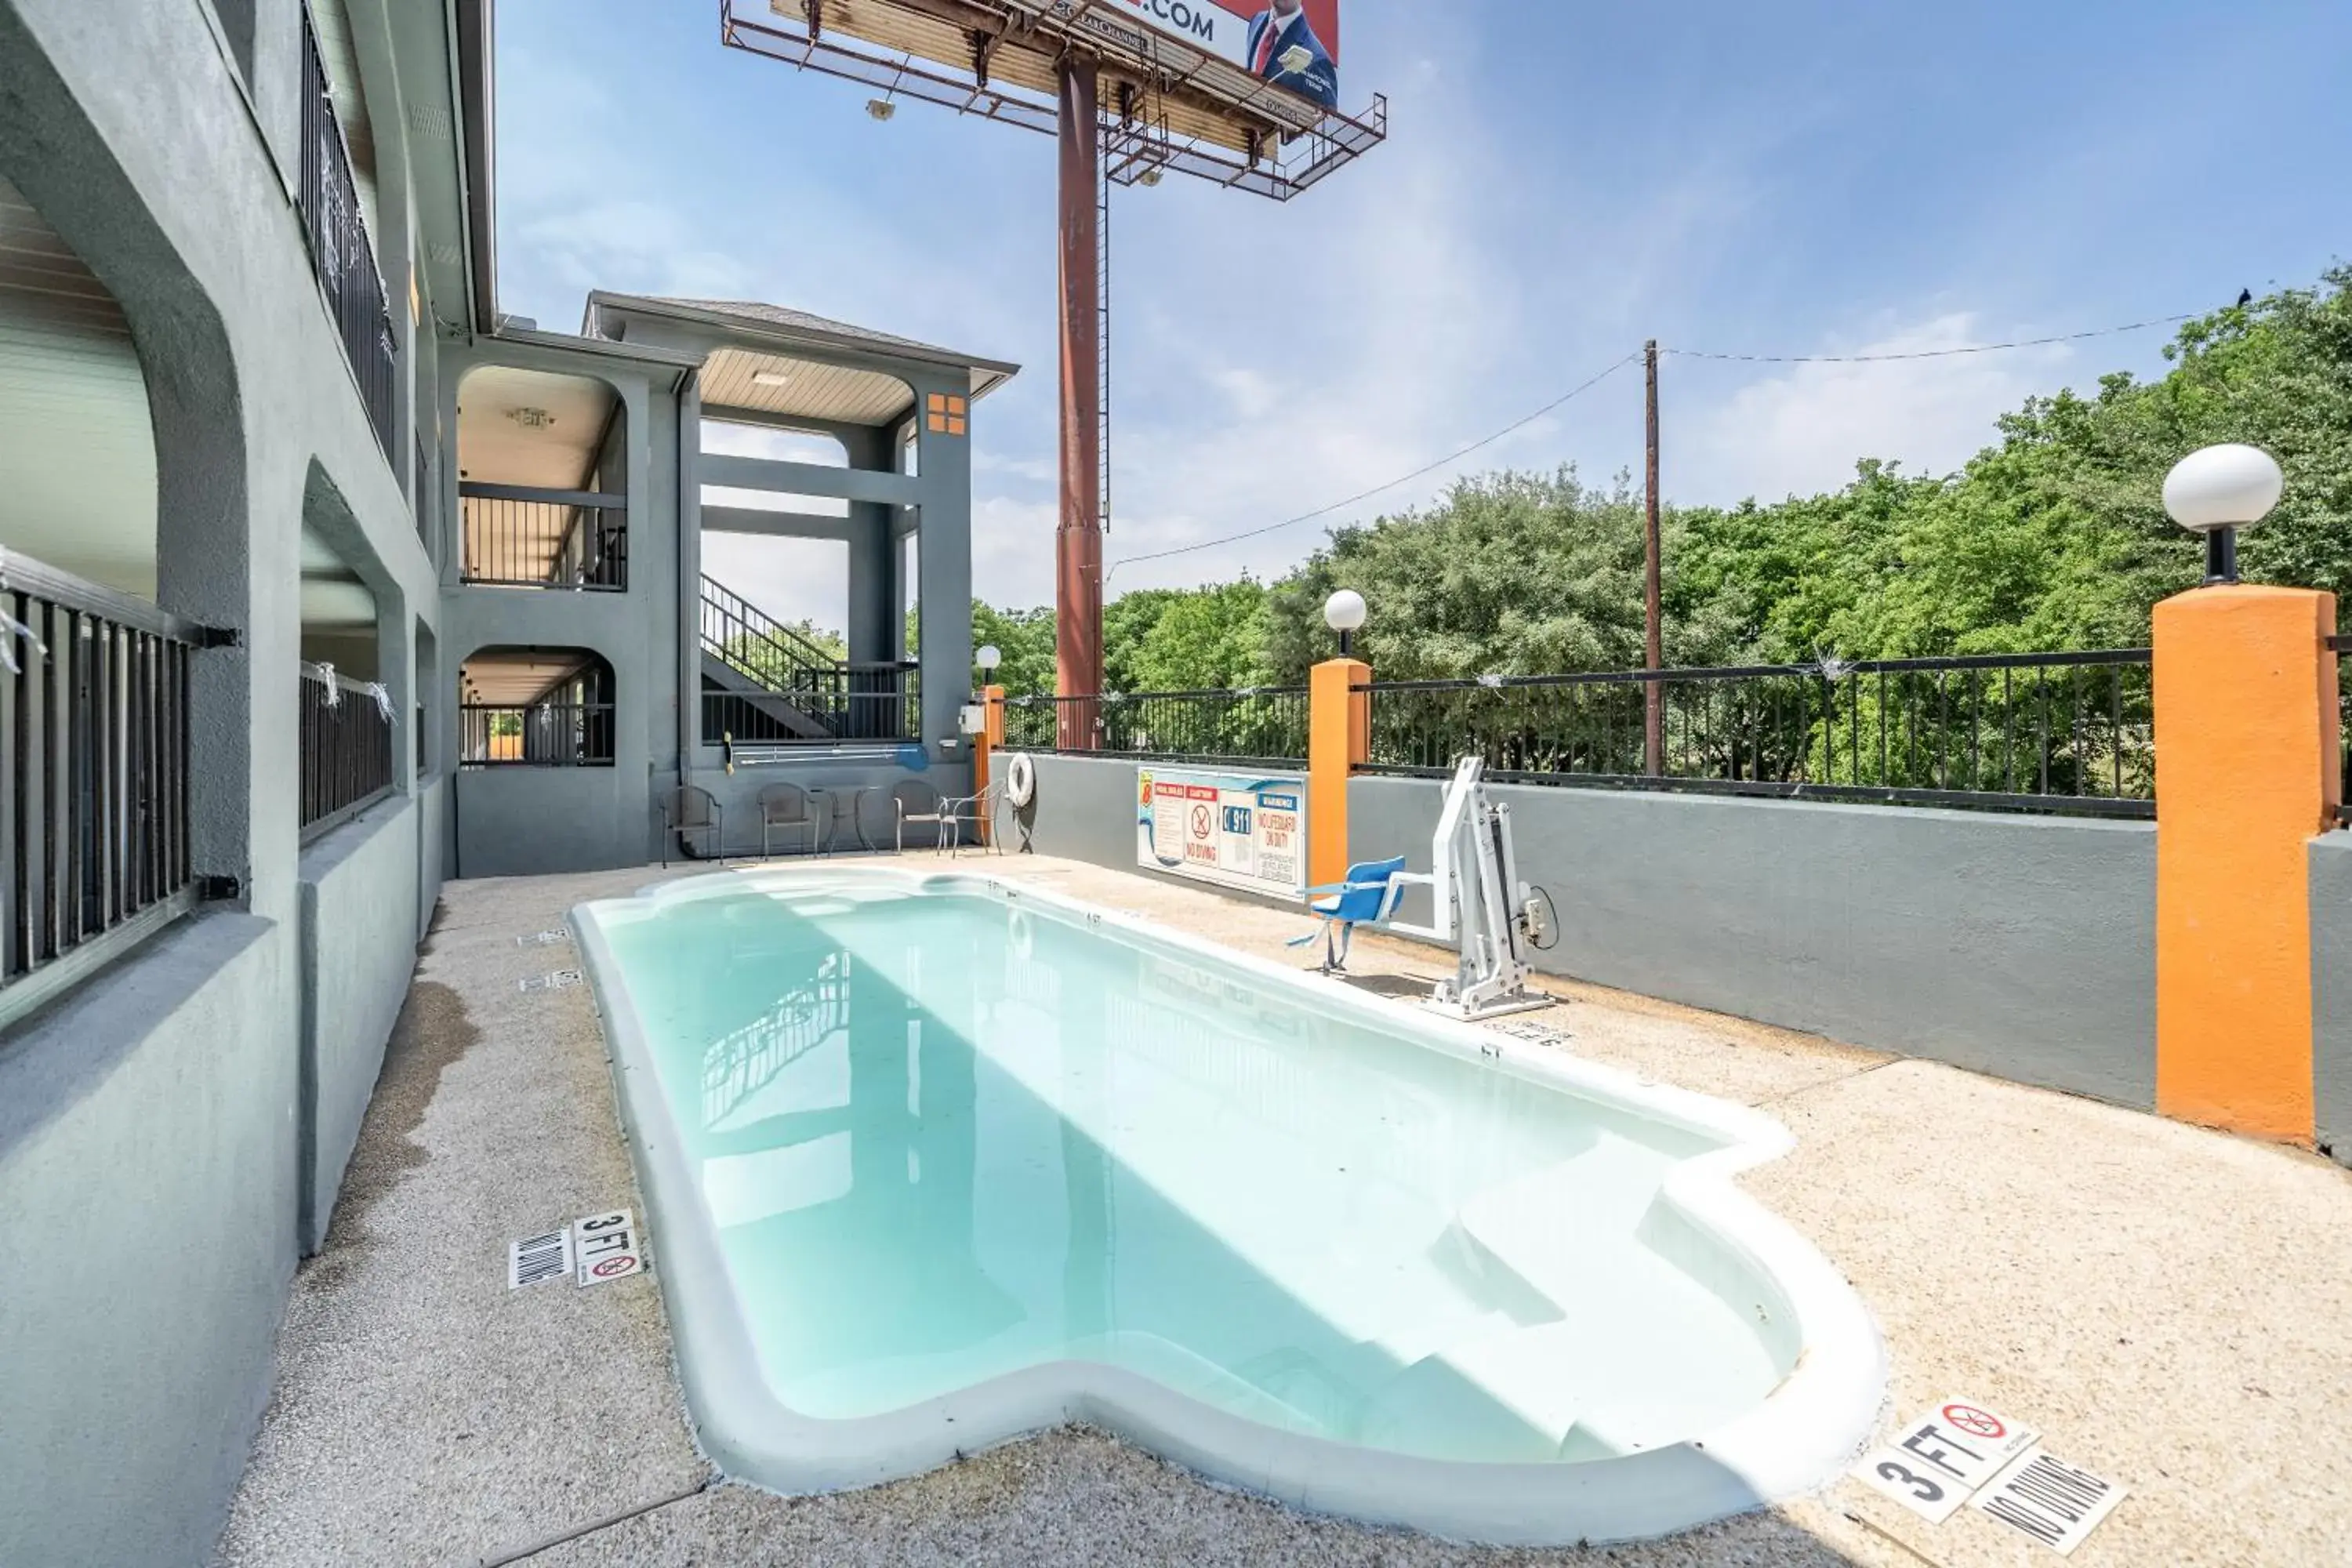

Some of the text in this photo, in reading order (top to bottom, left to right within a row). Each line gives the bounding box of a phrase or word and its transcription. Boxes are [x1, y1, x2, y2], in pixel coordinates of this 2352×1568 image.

[1127, 0, 1213, 41] .COM
[1233, 808, 1250, 833] 911
[1186, 843, 1216, 861] NO DIVING
[583, 1215, 630, 1255] 3 FT
[1876, 1424, 1985, 1502] 3 FT
[1982, 1454, 2110, 1546] NO DIVING
